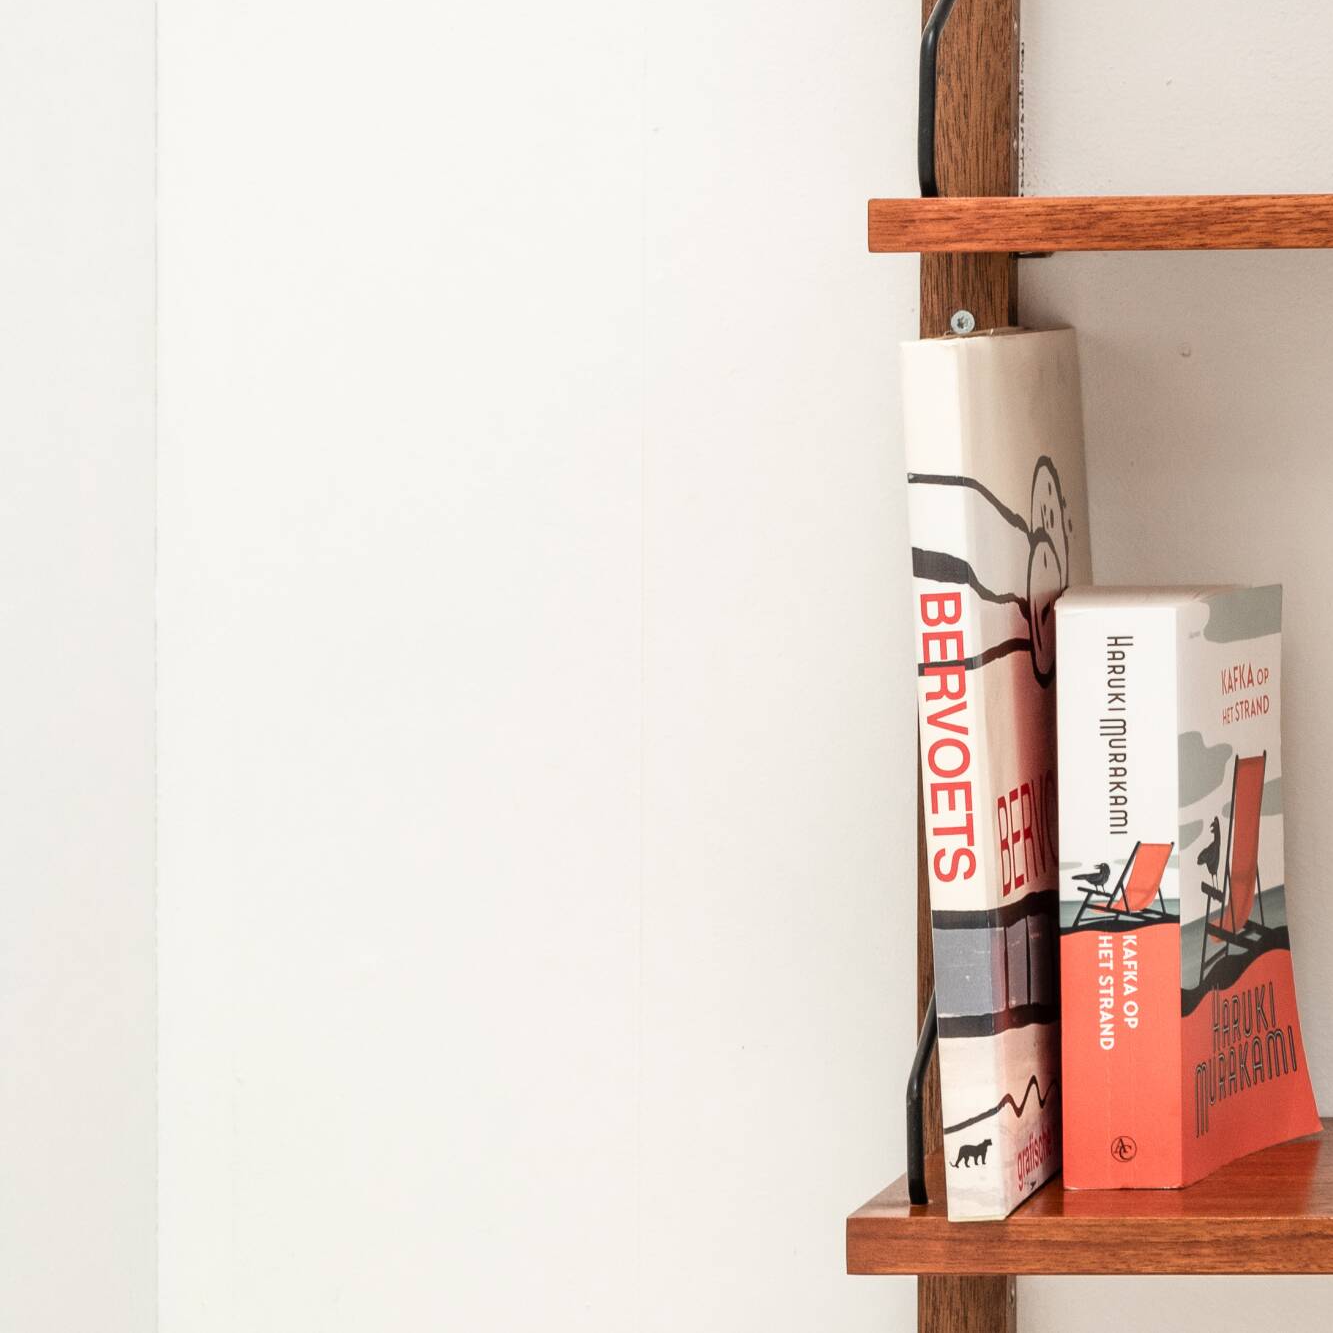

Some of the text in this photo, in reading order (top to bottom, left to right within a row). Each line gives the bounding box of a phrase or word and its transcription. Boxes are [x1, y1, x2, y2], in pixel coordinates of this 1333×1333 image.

[1099, 635, 1134, 835] HARUKI MURAKAMI
[1221, 662, 1270, 695] KAFKA OP
[1222, 694, 1270, 726] HET STRAND
[920, 591, 976, 883] BERVOETS
[998, 769, 1059, 898] BERVO
[1098, 935, 1116, 1051] HET STRAND
[1122, 934, 1139, 1029] KAFKA OP
[1212, 979, 1277, 1053] HARUKI
[1195, 1025, 1298, 1138] MURAKAMI
